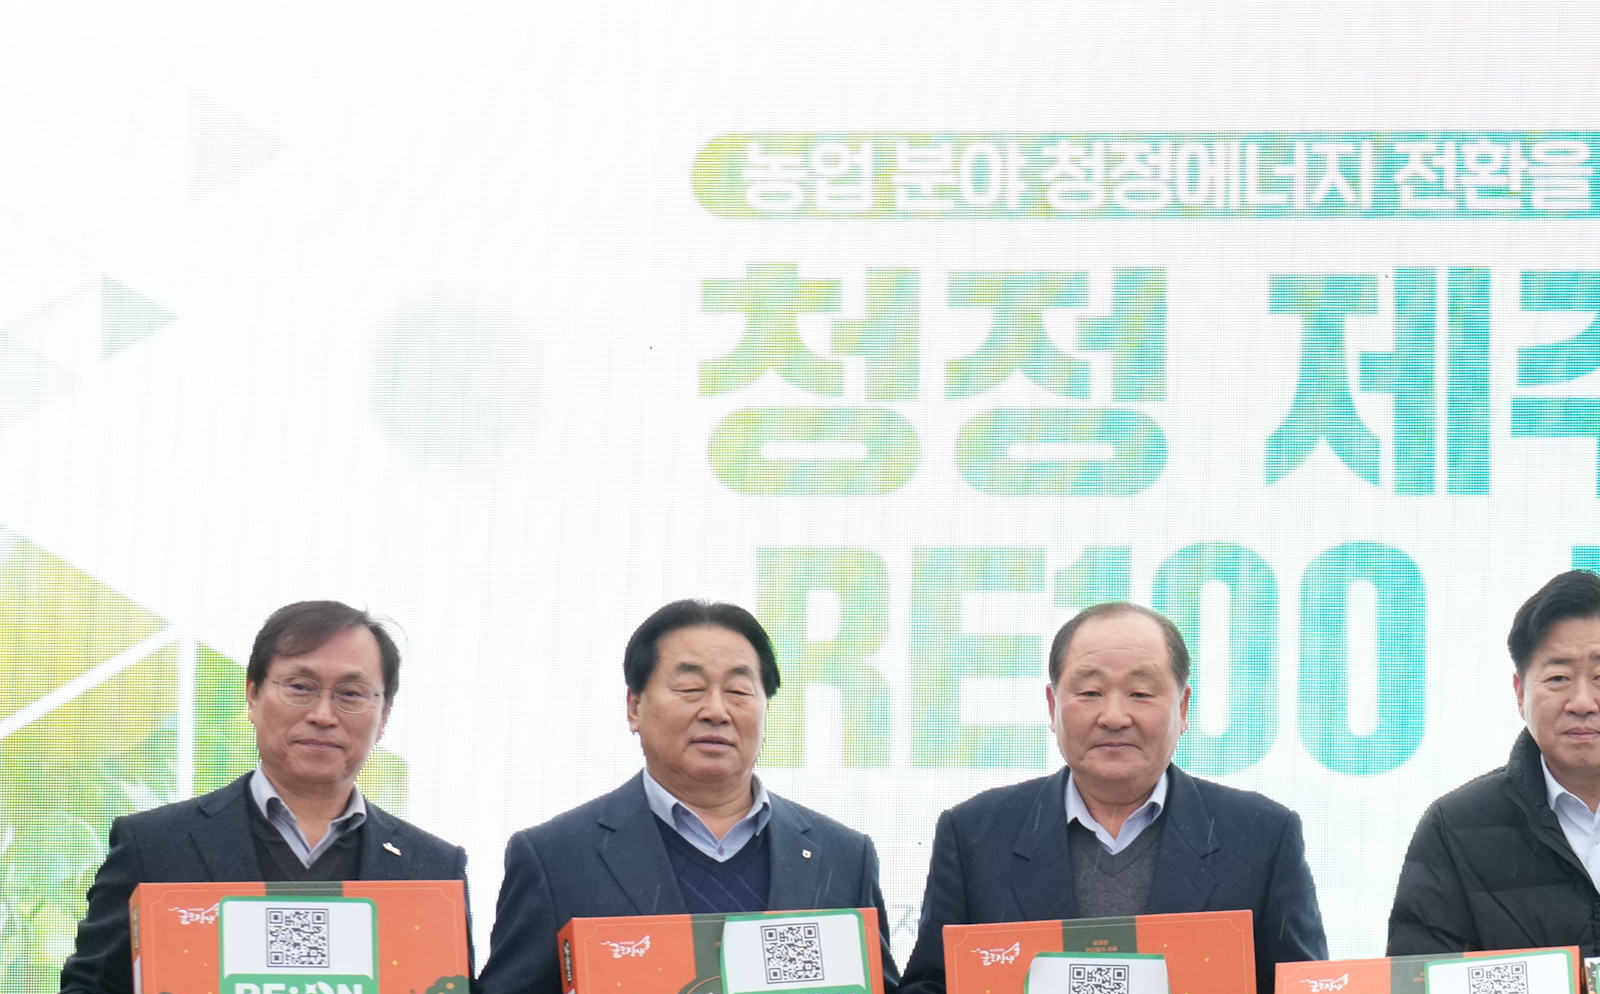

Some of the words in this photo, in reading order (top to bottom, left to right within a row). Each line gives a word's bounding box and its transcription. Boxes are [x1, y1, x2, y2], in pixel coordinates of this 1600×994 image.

[743, 140, 874, 211] 농업
[893, 140, 1022, 211] 분야
[1040, 139, 1375, 211] 청정에너지
[1394, 139, 1594, 212] 전환을
[697, 261, 1169, 498] 청정
[756, 540, 1428, 776] RE00
